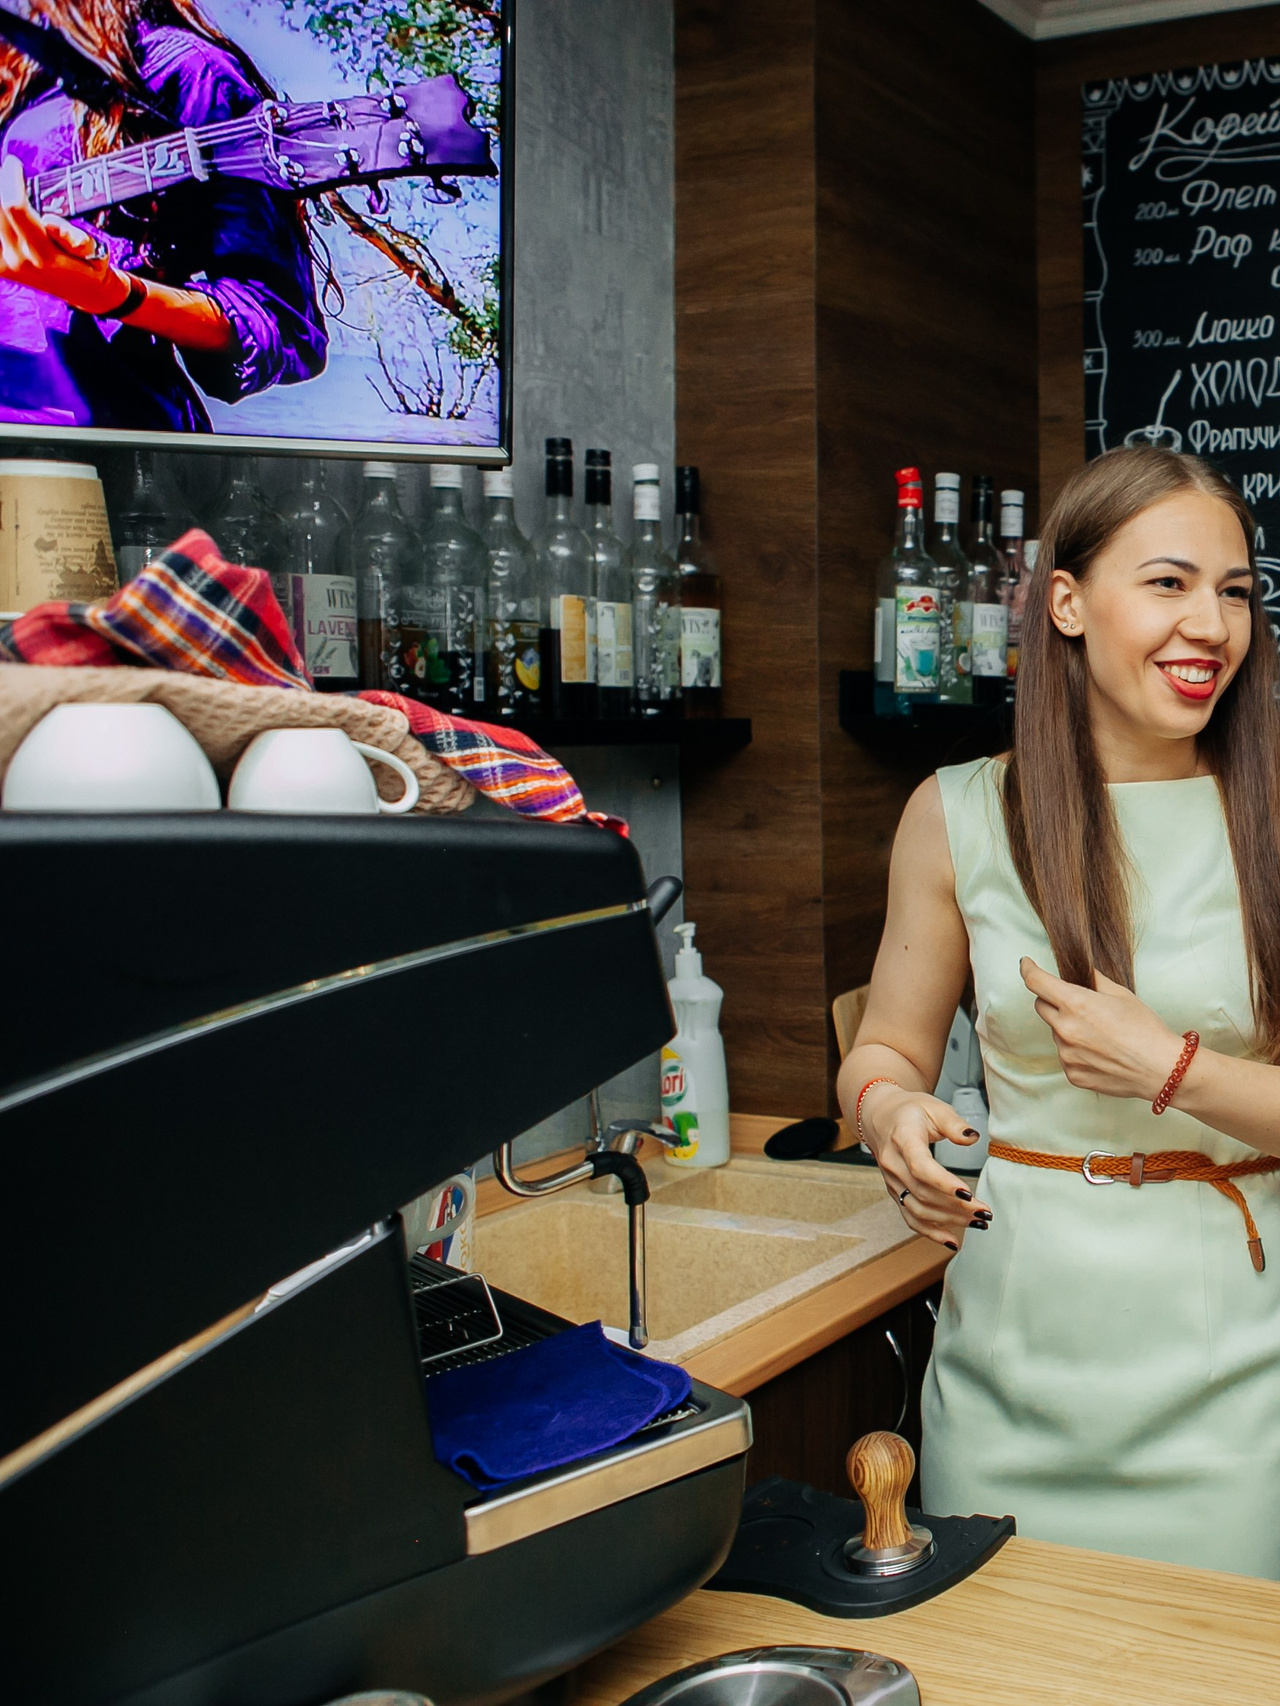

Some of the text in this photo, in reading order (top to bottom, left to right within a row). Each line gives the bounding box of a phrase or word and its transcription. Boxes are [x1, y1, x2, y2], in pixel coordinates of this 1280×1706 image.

[1182, 180, 1278, 216] Флет
[1189, 226, 1253, 267] Раф
[1187, 311, 1275, 348] Мокко
